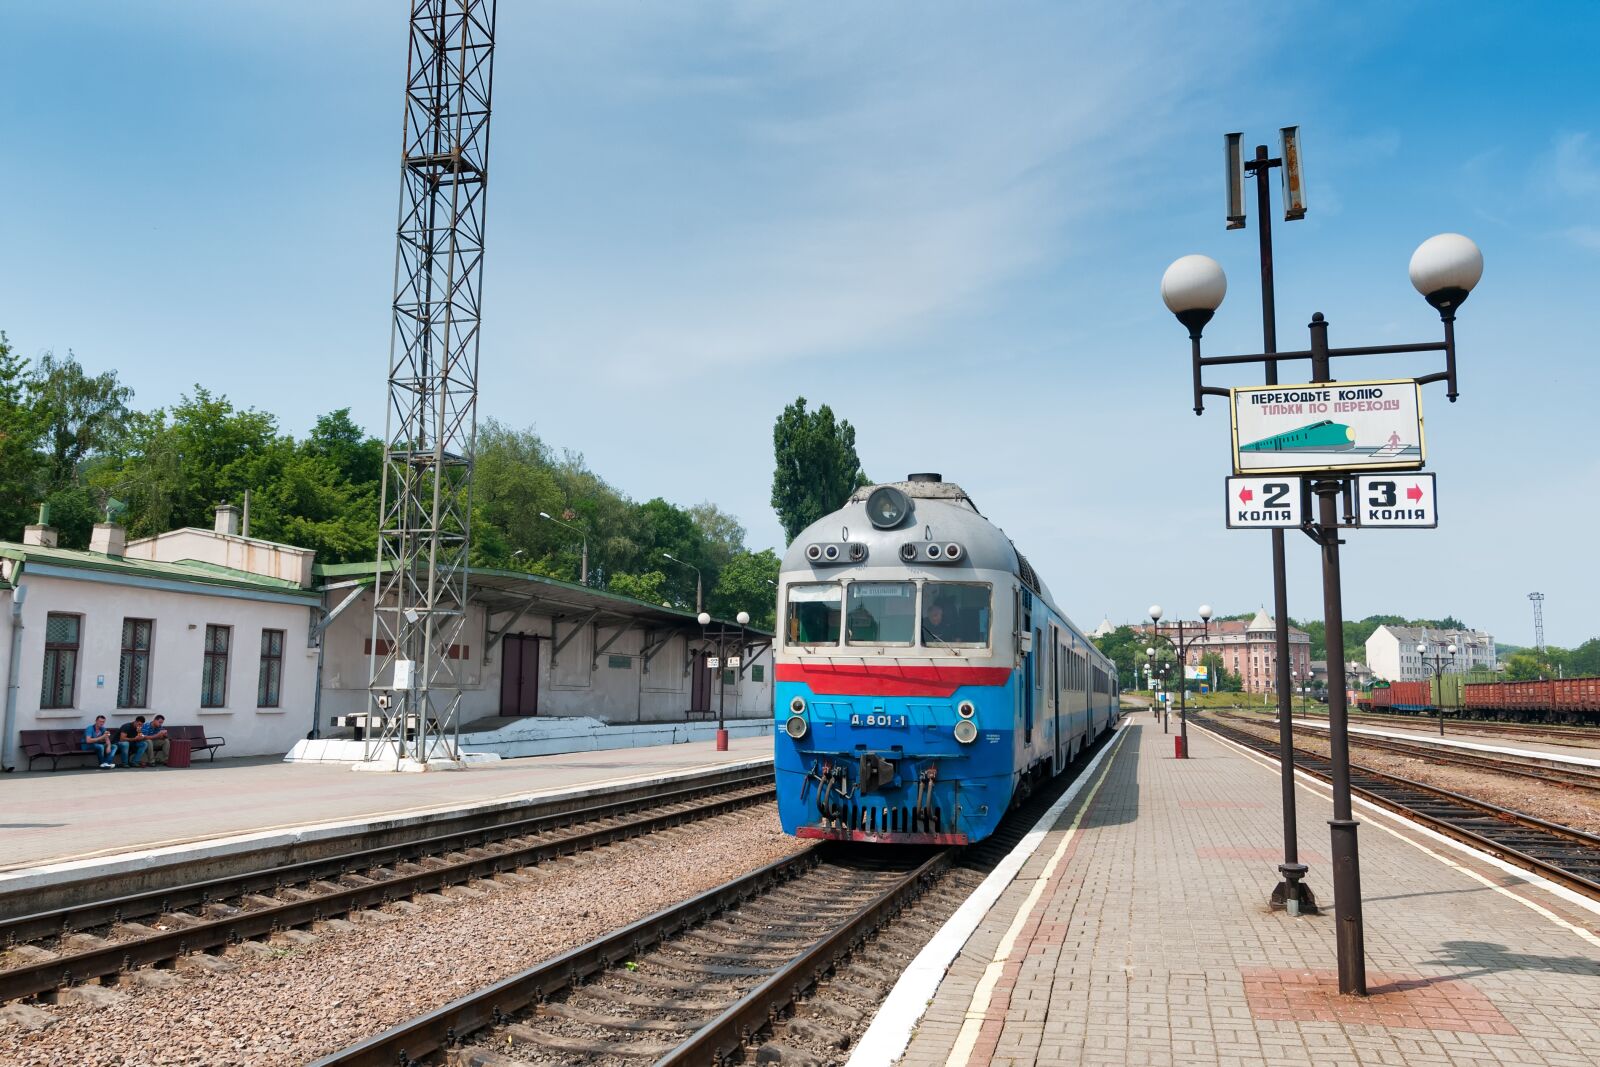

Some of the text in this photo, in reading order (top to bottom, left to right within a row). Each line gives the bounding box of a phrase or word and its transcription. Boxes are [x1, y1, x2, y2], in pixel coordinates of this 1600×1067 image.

[1251, 388, 1383, 405] ПЕРЕХОДЬТЕ КОЛІЮ
[1261, 400, 1400, 416] ТІЛЬКИ ПО ПЕРЕХОДУ
[1262, 483, 1291, 509] 2
[1368, 481, 1397, 507] 3
[1238, 510, 1292, 521] КОЛІЯ
[1369, 509, 1425, 520] КОЛІЯ
